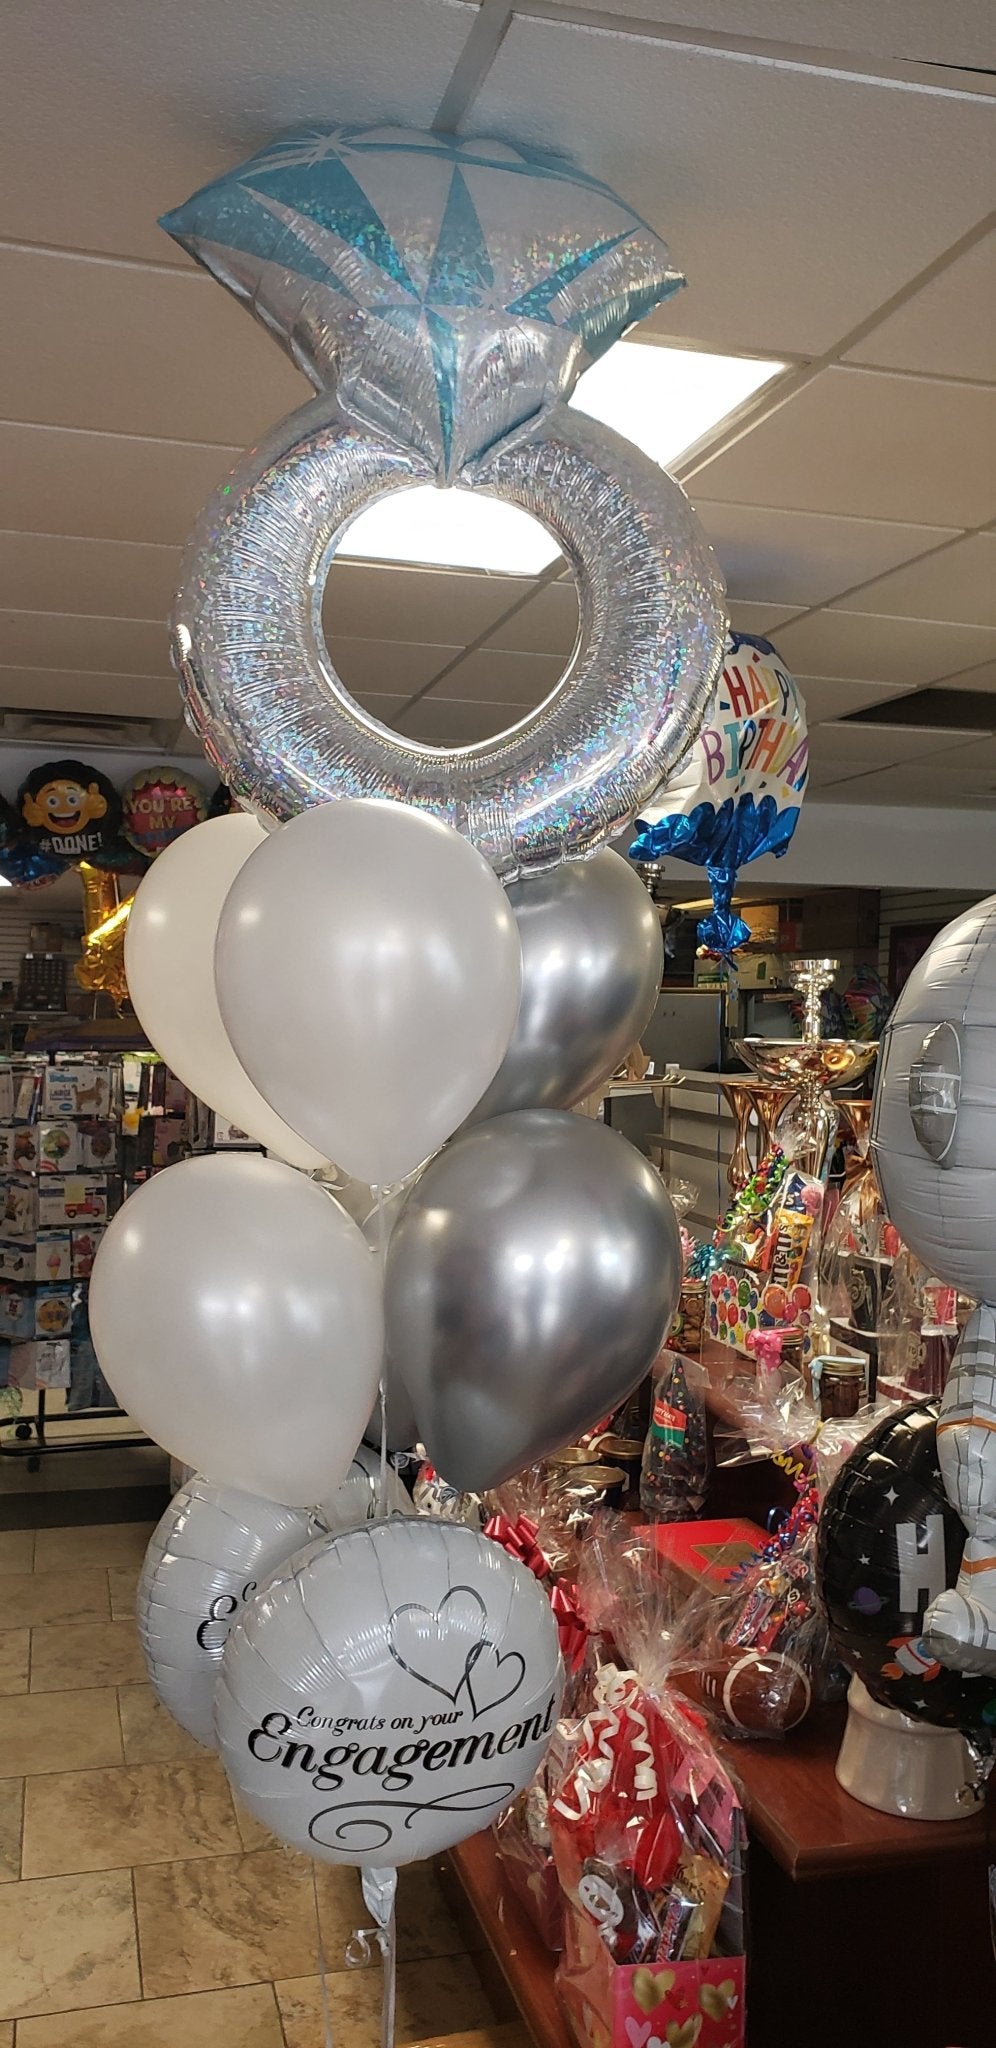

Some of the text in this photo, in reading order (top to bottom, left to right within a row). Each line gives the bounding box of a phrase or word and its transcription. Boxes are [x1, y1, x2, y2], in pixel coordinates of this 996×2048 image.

[700, 717, 809, 786] BIRTHDA
[149, 815, 176, 830] MY
[39, 831, 103, 855] #DONE!
[296, 1705, 464, 1737] Congrats on your
[247, 1693, 557, 1792] Engagement
